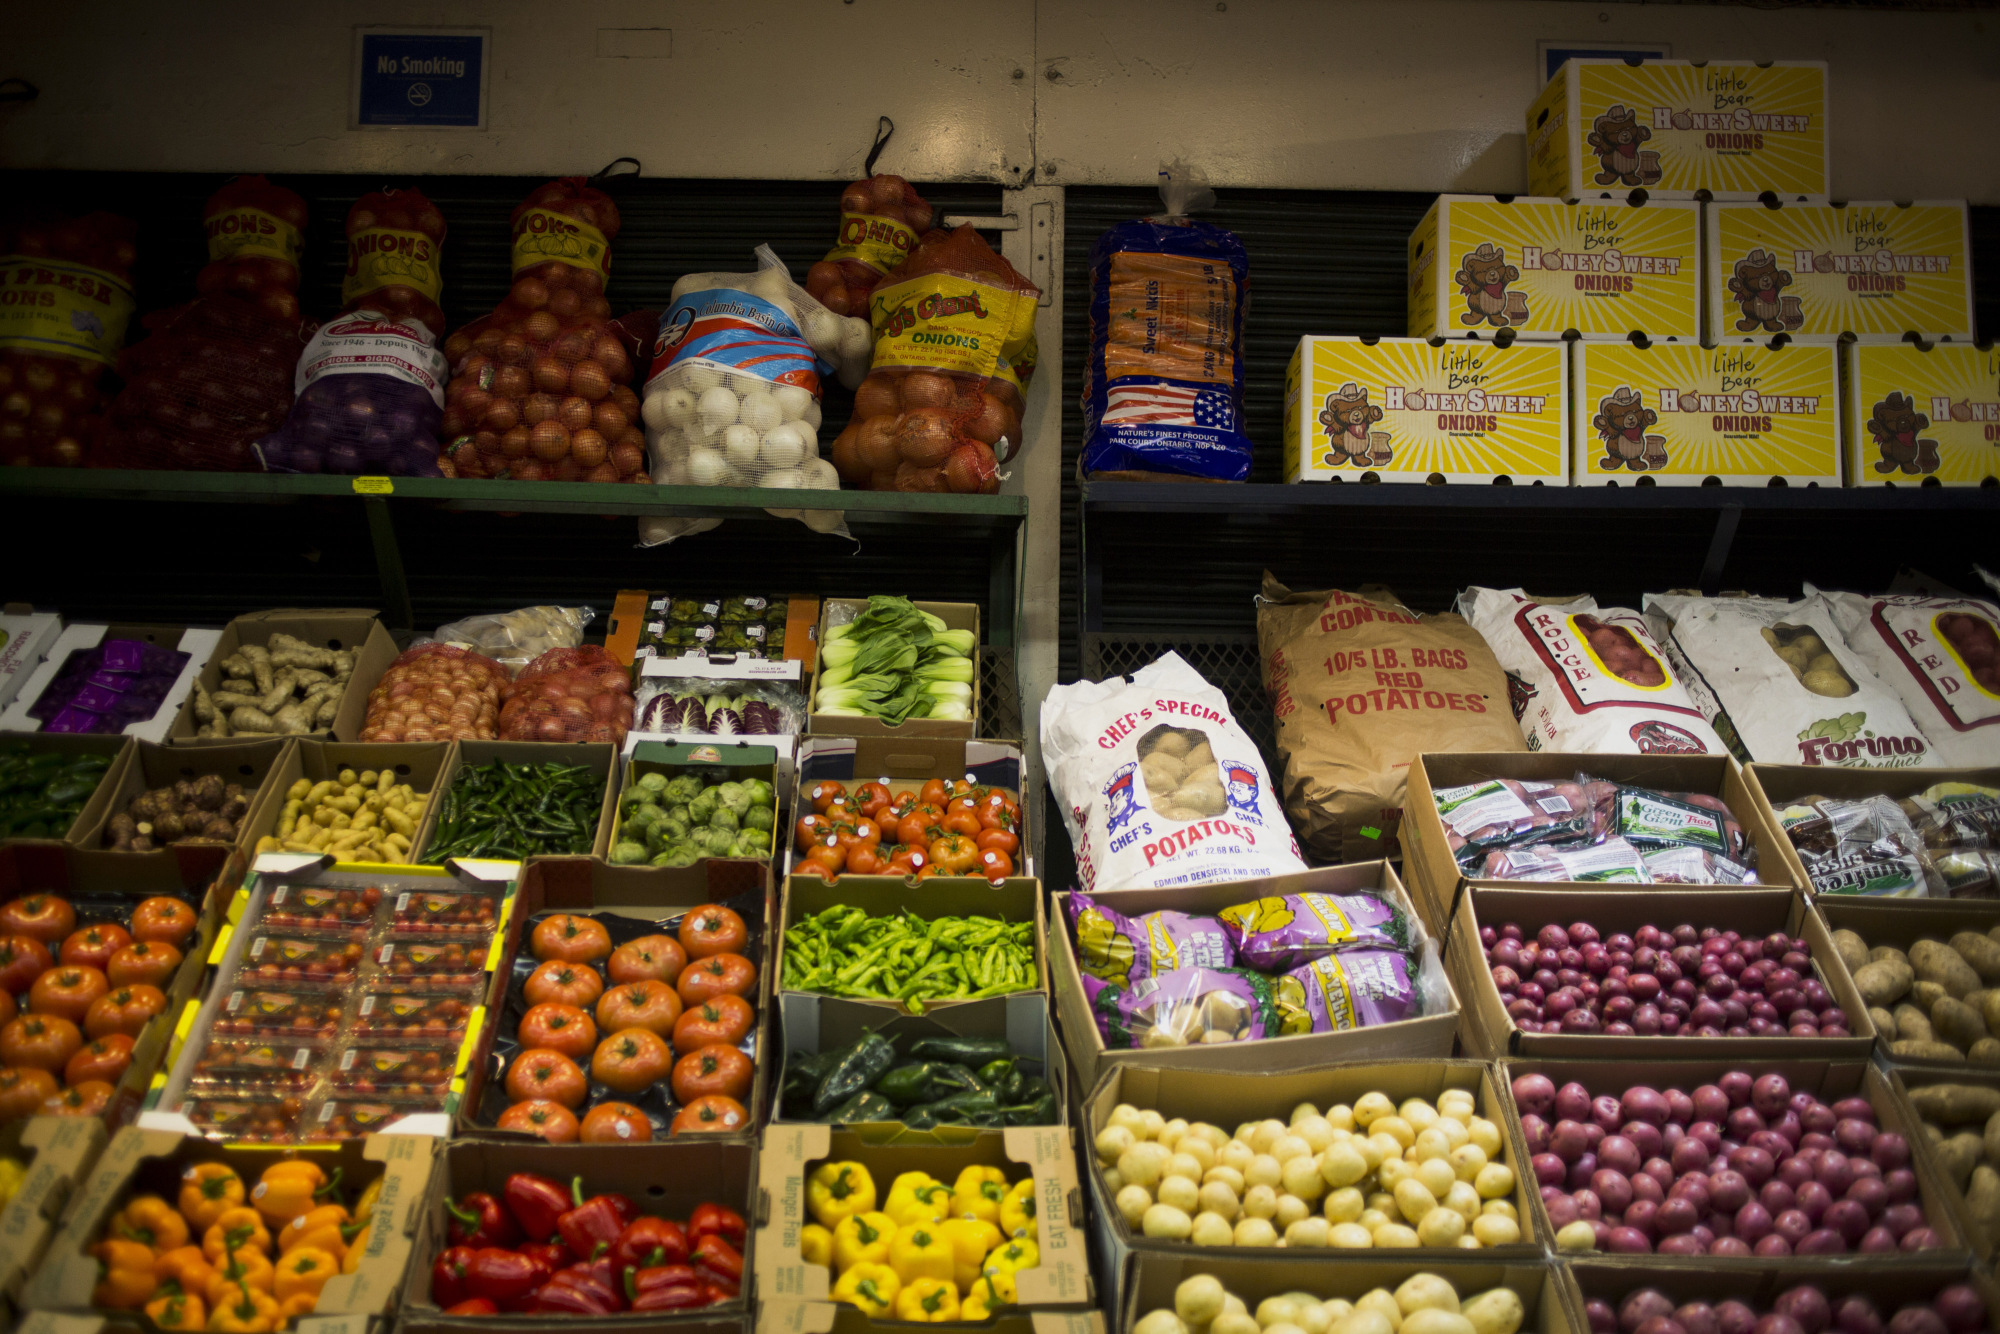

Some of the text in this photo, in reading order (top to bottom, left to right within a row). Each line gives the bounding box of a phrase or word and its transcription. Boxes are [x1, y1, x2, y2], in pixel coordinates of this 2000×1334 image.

[377, 55, 465, 78] No Smoking
[1707, 71, 1747, 92] Little
[1715, 94, 1754, 110] Bear
[1705, 133, 1764, 150] ONIONS
[1577, 211, 1618, 232] Little
[1847, 213, 1887, 233] Little
[1584, 234, 1624, 249] Bear
[1854, 235, 1894, 252] Bear
[15, 268, 112, 305] FRESH
[1574, 274, 1633, 292] ONIONS
[1847, 275, 1906, 292] ONIONS
[700, 300, 746, 316] Columbia
[747, 307, 775, 329] Basin
[917, 290, 988, 320] Giant
[912, 332, 980, 350] ONIONS
[953, 326, 983, 337] OREGON
[1142, 317, 1158, 354] Sweet
[344, 338, 364, 347] 1946
[374, 339, 408, 350] Depuis
[321, 356, 356, 367] ONIONS
[365, 355, 409, 371] OIGNONS
[1441, 350, 1483, 371] Little
[1713, 353, 1755, 373] Little
[1448, 373, 1489, 389] Bear
[1721, 375, 1762, 392] Bear
[1438, 414, 1497, 432] ONIONS
[1713, 415, 1772, 432] ONIONS
[1109, 437, 1126, 445] PAIN
[1156, 440, 1192, 449] ONTARIO,
[1155, 431, 1181, 439] FINEST
[1183, 432, 1219, 442] PRODUCE
[1534, 614, 1591, 682] ROUGE
[1324, 648, 1468, 675] 10/5 LB. BAGS
[1901, 628, 1960, 695] RED
[1375, 671, 1424, 689] RED
[1325, 689, 1487, 725] POTATOES
[1098, 699, 1227, 749] CHEF'S SPECIAL
[1798, 731, 1926, 766] Forino
[1642, 804, 1714, 827] Green Fresh
[1644, 812, 1684, 827] Giant
[1110, 821, 1153, 854] CHEF'S
[1142, 819, 1256, 867] POTATOES
[1154, 875, 1189, 888] EDMUND
[1191, 868, 1231, 881] DENSIESKI
[1233, 868, 1248, 876] AND
[1250, 868, 1271, 876] SONS
[782, 1176, 802, 1217] Mangez
[1044, 1177, 1062, 1220] FRESH
[365, 1209, 394, 1257] Mangez
[783, 1221, 801, 1249] Frais
[1048, 1223, 1068, 1250] EAT
